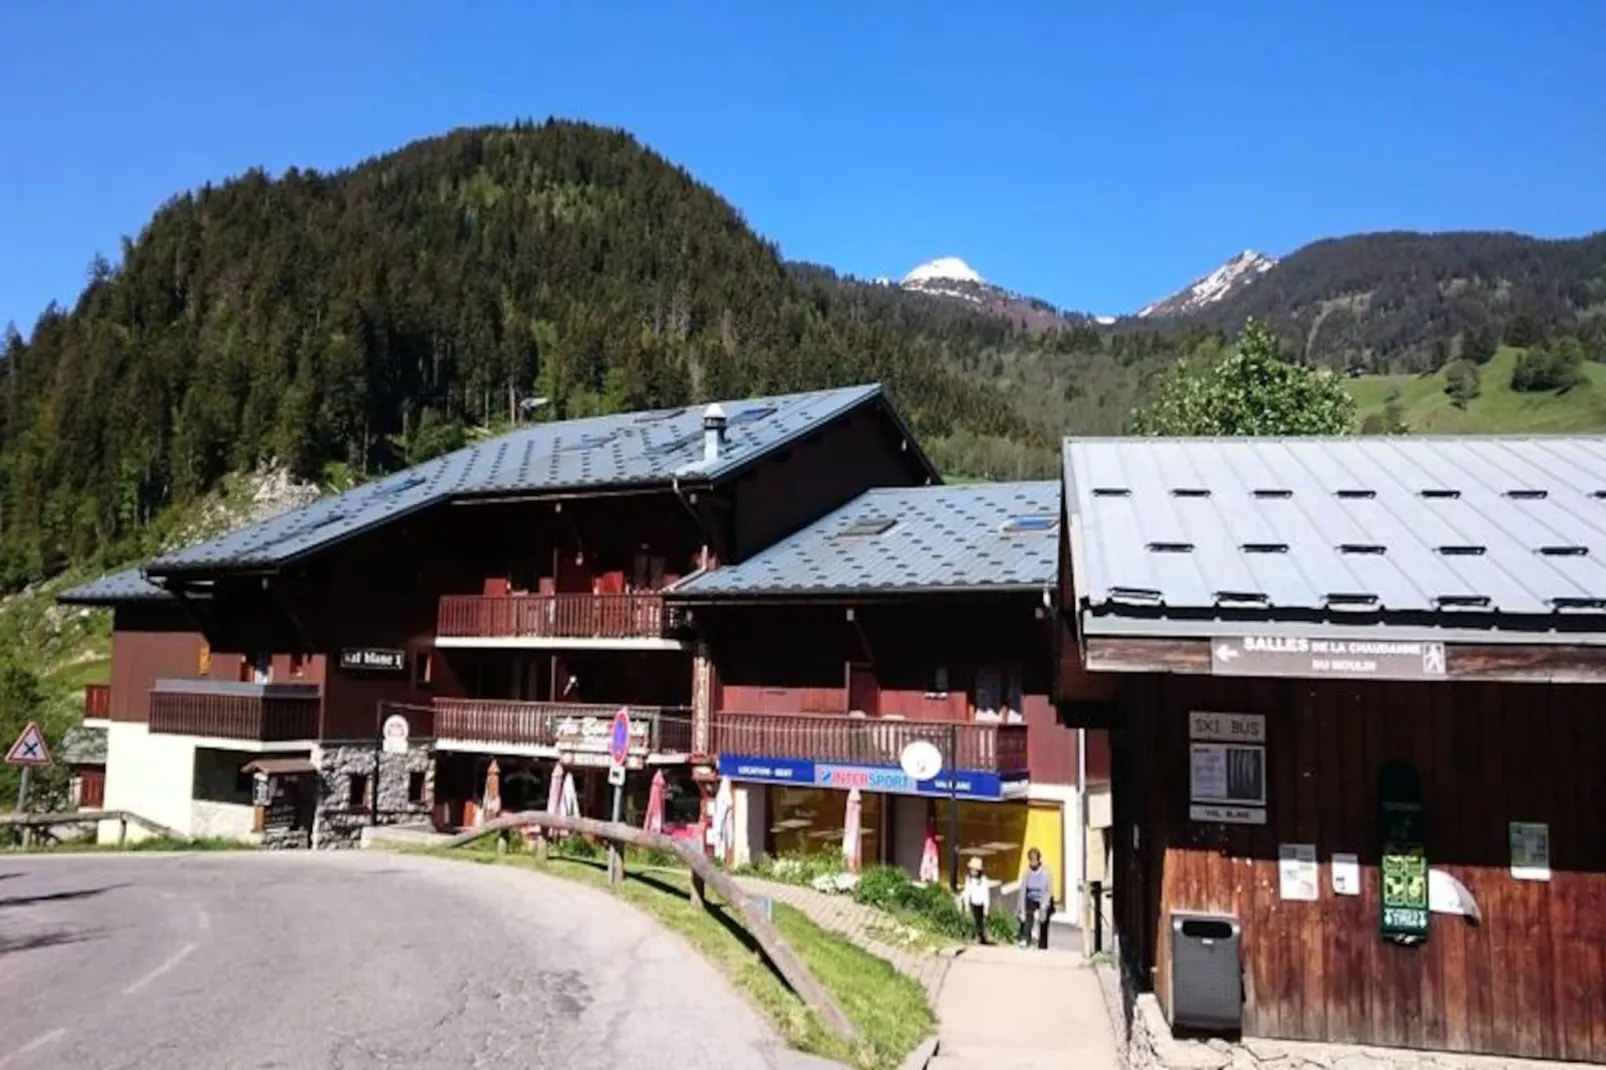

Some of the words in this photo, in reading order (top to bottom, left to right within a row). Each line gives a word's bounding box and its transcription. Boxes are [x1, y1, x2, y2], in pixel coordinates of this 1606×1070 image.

[1195, 718, 1220, 733] SKI
[1231, 719, 1260, 737] BUS
[833, 770, 908, 789] INTERSPORT
